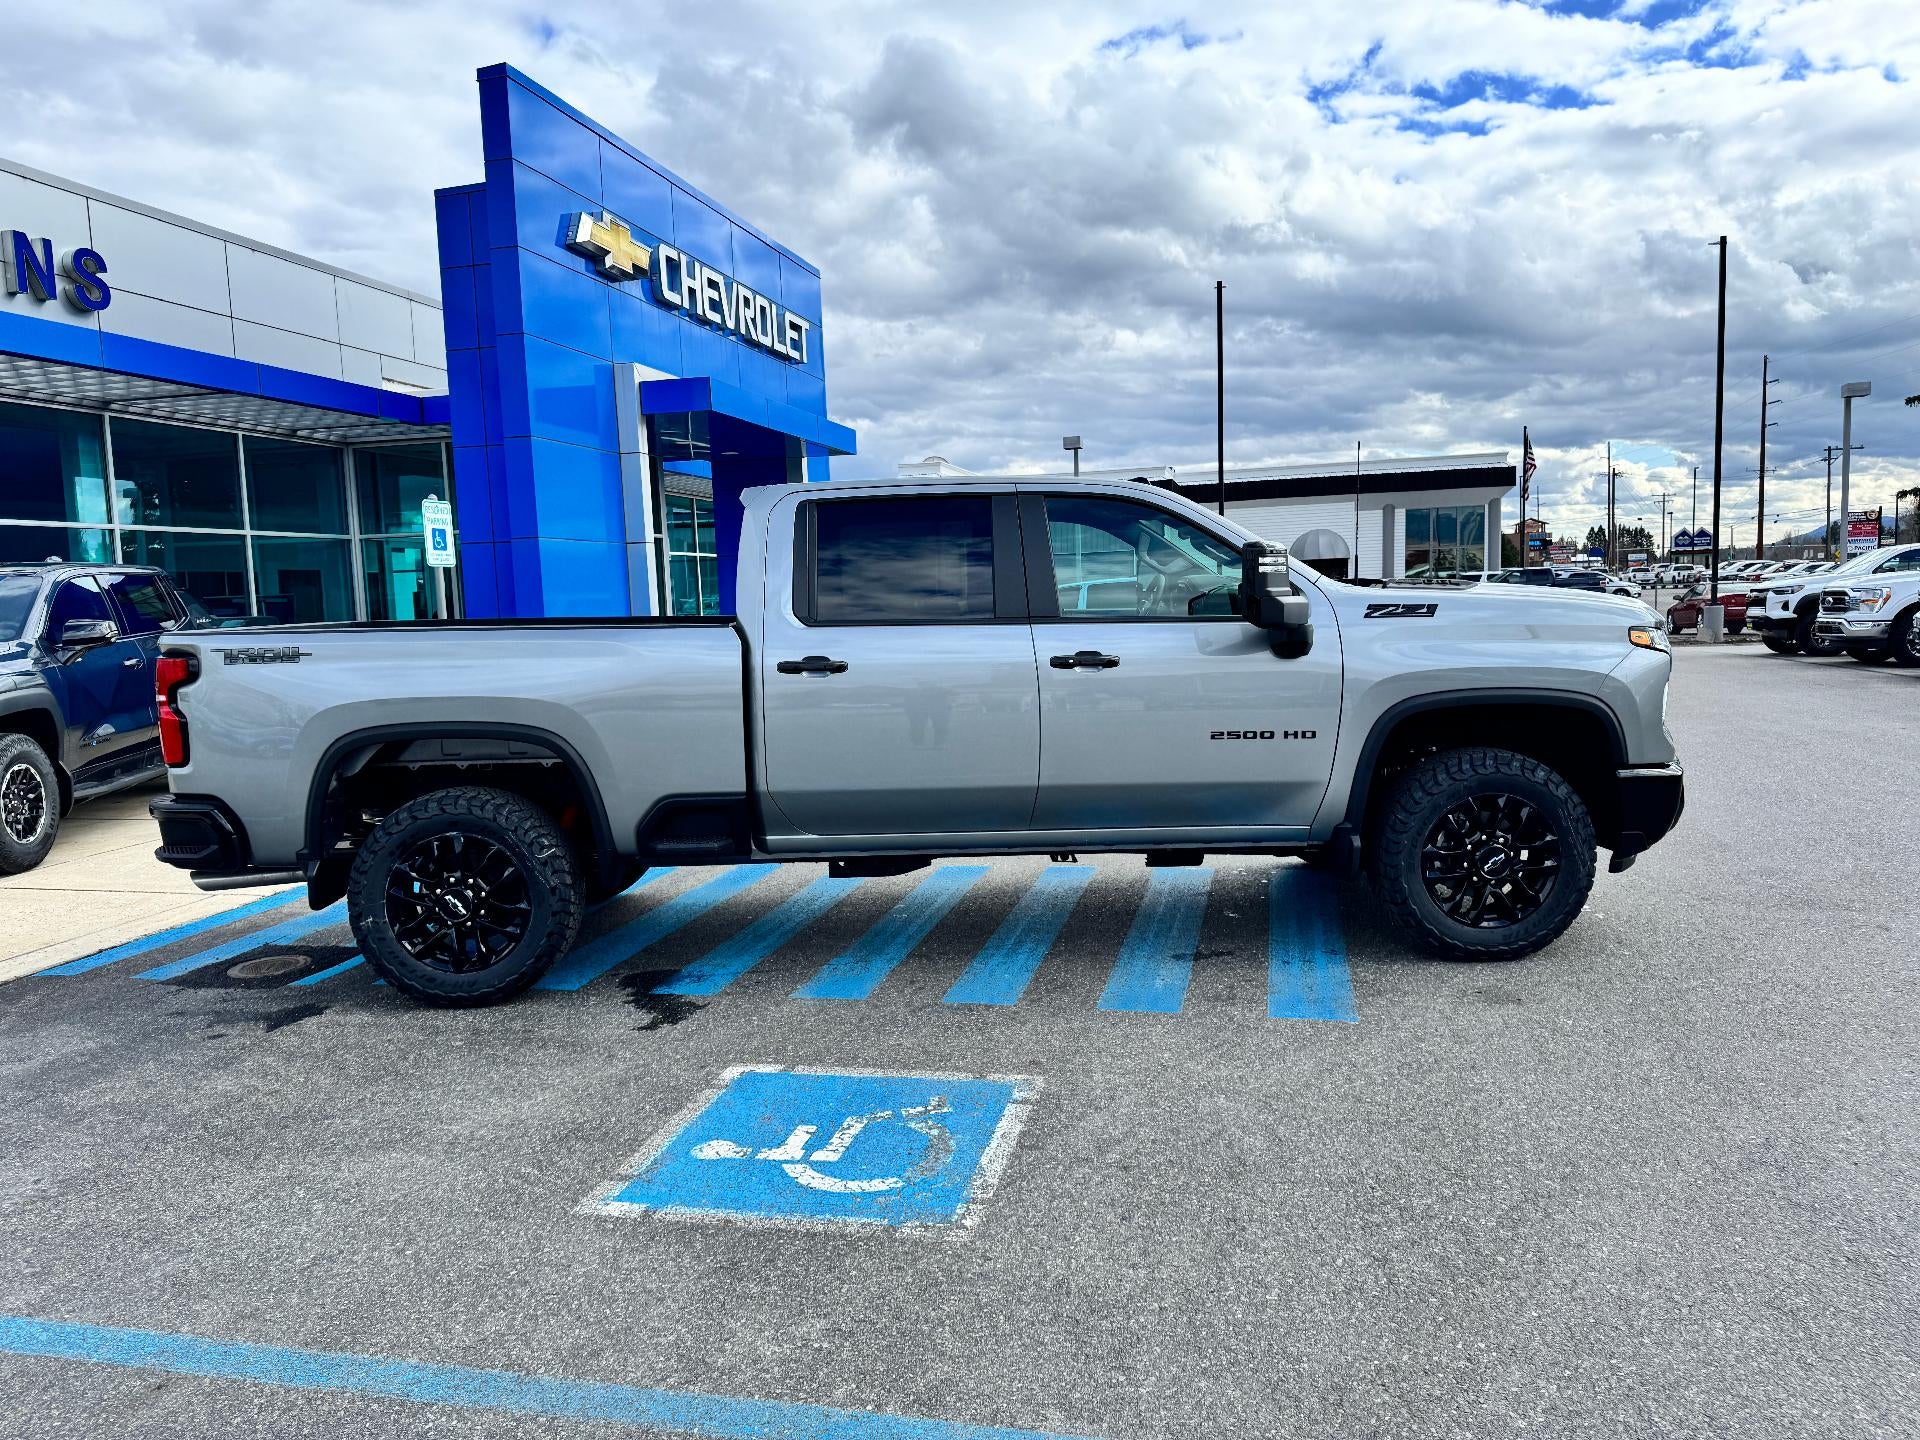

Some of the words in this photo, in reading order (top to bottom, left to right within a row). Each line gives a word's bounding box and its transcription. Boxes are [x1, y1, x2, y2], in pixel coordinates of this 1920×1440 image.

[658, 243, 810, 364] CHEVROLET
[1363, 603, 1439, 618] Z71
[1210, 730, 1275, 740] 2500
[1283, 730, 1317, 740] HD
